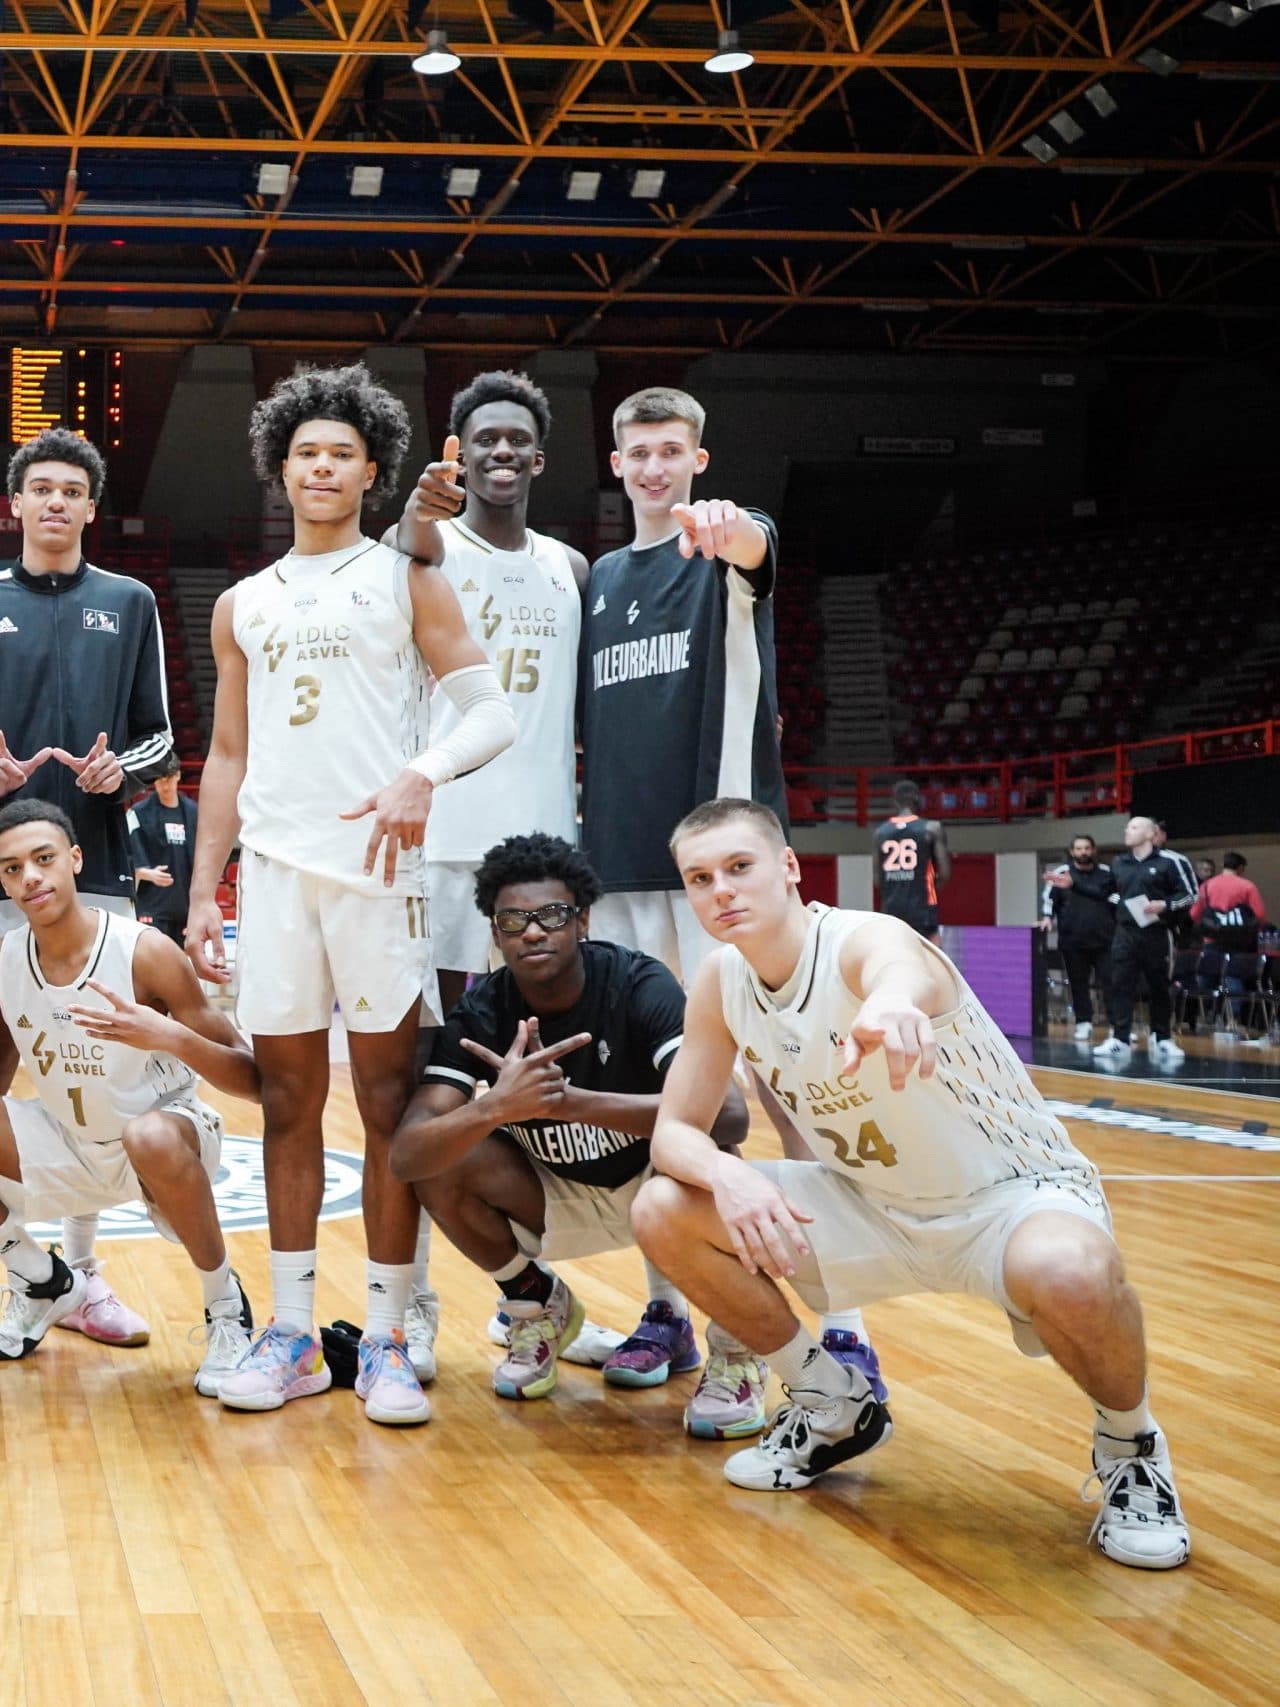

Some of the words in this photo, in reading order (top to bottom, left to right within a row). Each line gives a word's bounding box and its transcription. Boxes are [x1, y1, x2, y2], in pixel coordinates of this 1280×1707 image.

[510, 605, 557, 622] LDLC
[296, 624, 351, 645] LDLC
[511, 624, 558, 638] ASVEL
[296, 645, 351, 661] ASVEL
[496, 647, 541, 693] 15
[288, 674, 322, 726] 3
[881, 838, 918, 872] 26
[60, 1042, 105, 1060] LDLC
[63, 1062, 107, 1077] ASVEL
[67, 1087, 87, 1127] 1
[810, 1091, 874, 1117] ASVEL
